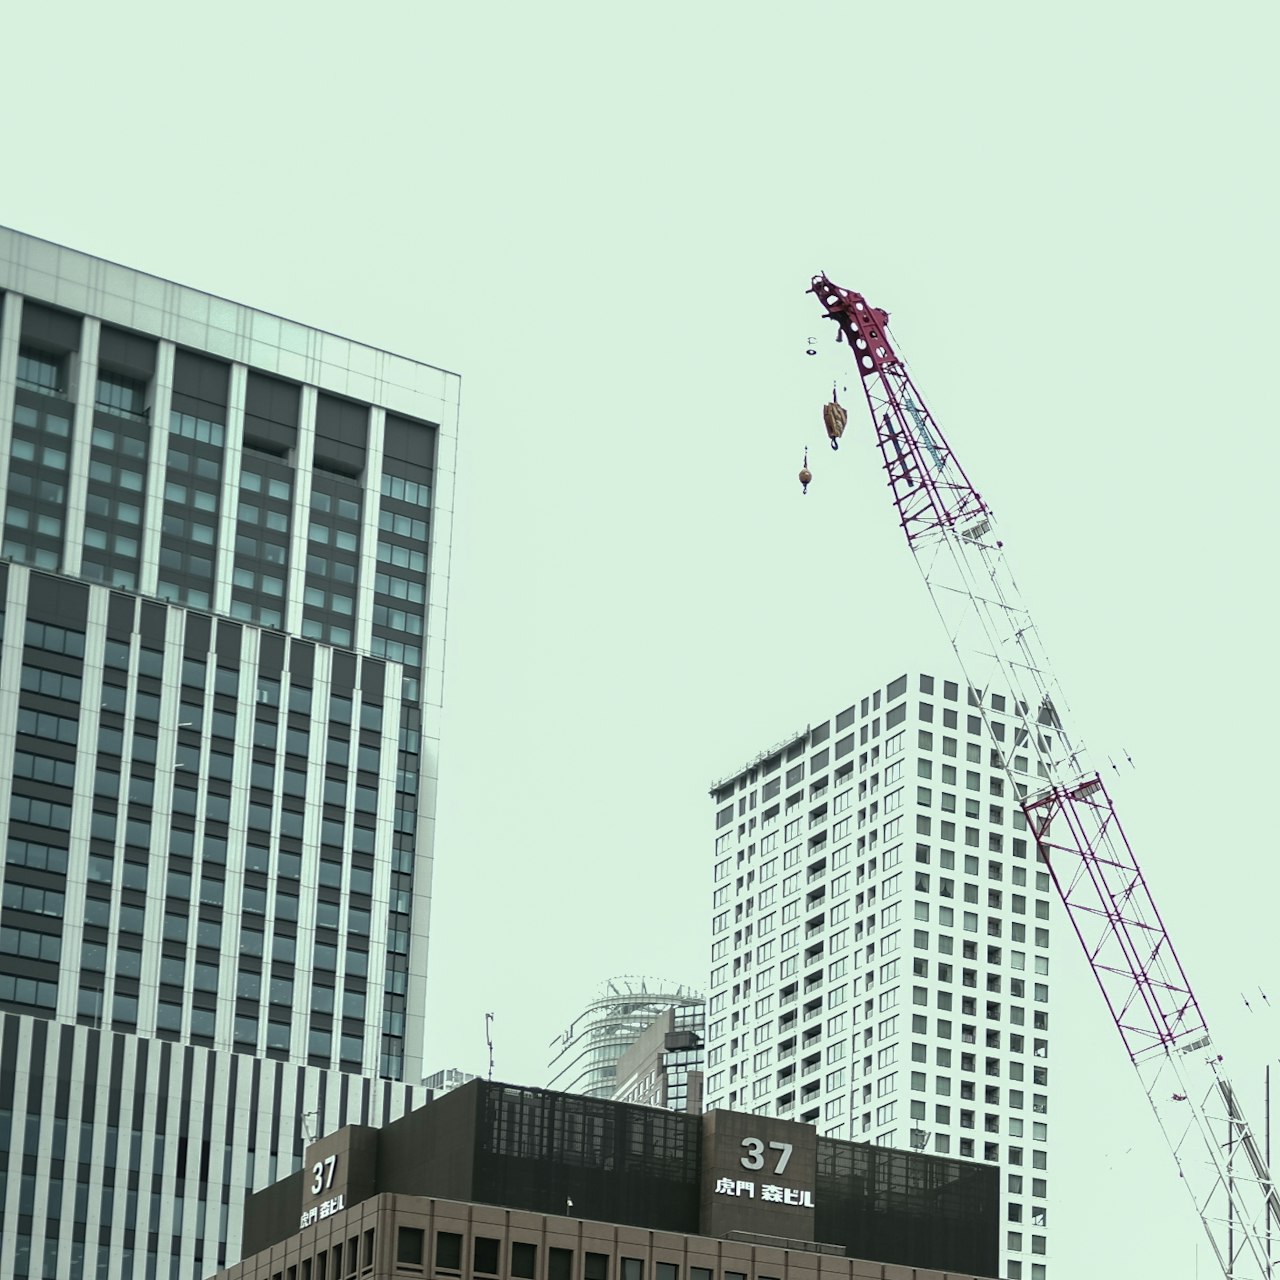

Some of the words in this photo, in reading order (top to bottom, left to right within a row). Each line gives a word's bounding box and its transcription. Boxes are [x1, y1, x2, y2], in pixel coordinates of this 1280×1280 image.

[740, 1136, 793, 1175] 37
[311, 1154, 337, 1195] 37
[319, 1194, 345, 1219] 森ビル
[761, 1184, 815, 1208] 森ビル
